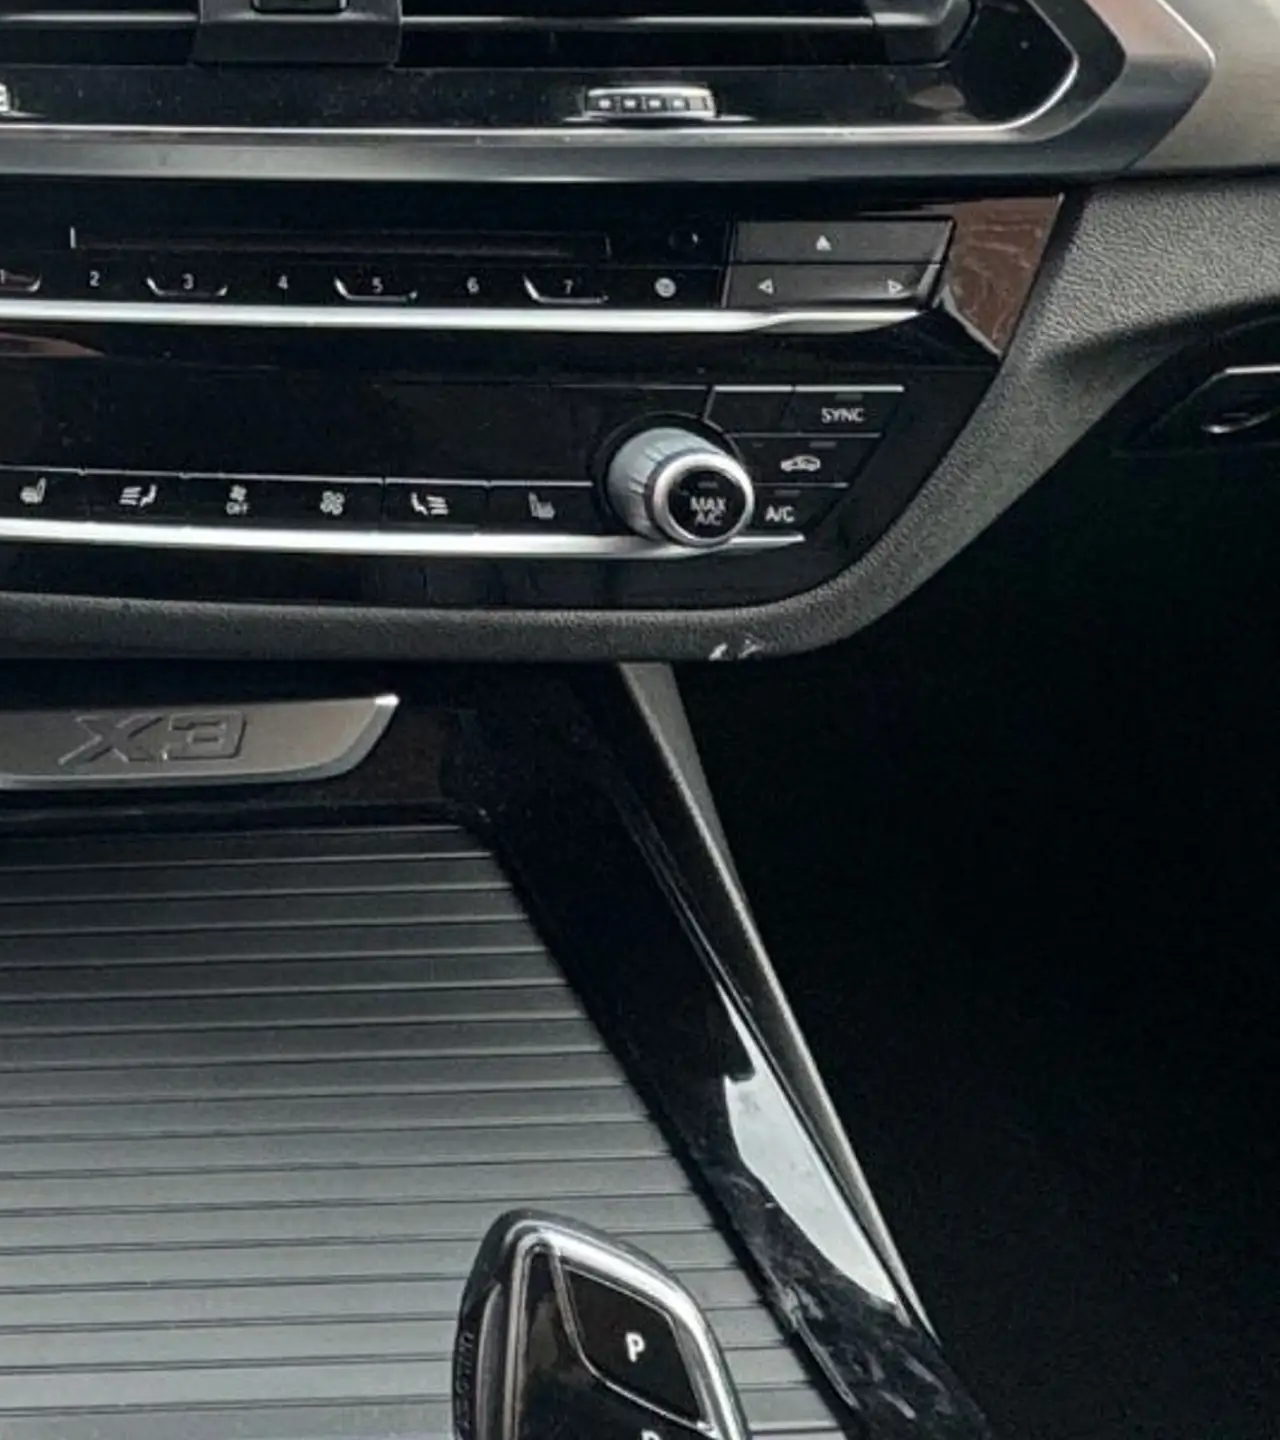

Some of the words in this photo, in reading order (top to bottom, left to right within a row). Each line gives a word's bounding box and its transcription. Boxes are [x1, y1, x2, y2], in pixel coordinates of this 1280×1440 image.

[89, 270, 100, 287] 2
[183, 272, 194, 290] 3
[277, 274, 289, 291] 4
[371, 276, 384, 294] 5
[467, 276, 479, 294] 6
[821, 406, 866, 424] SYNC
[690, 496, 726, 511] MAX
[765, 504, 795, 524] A/C
[626, 1331, 646, 1363] P
